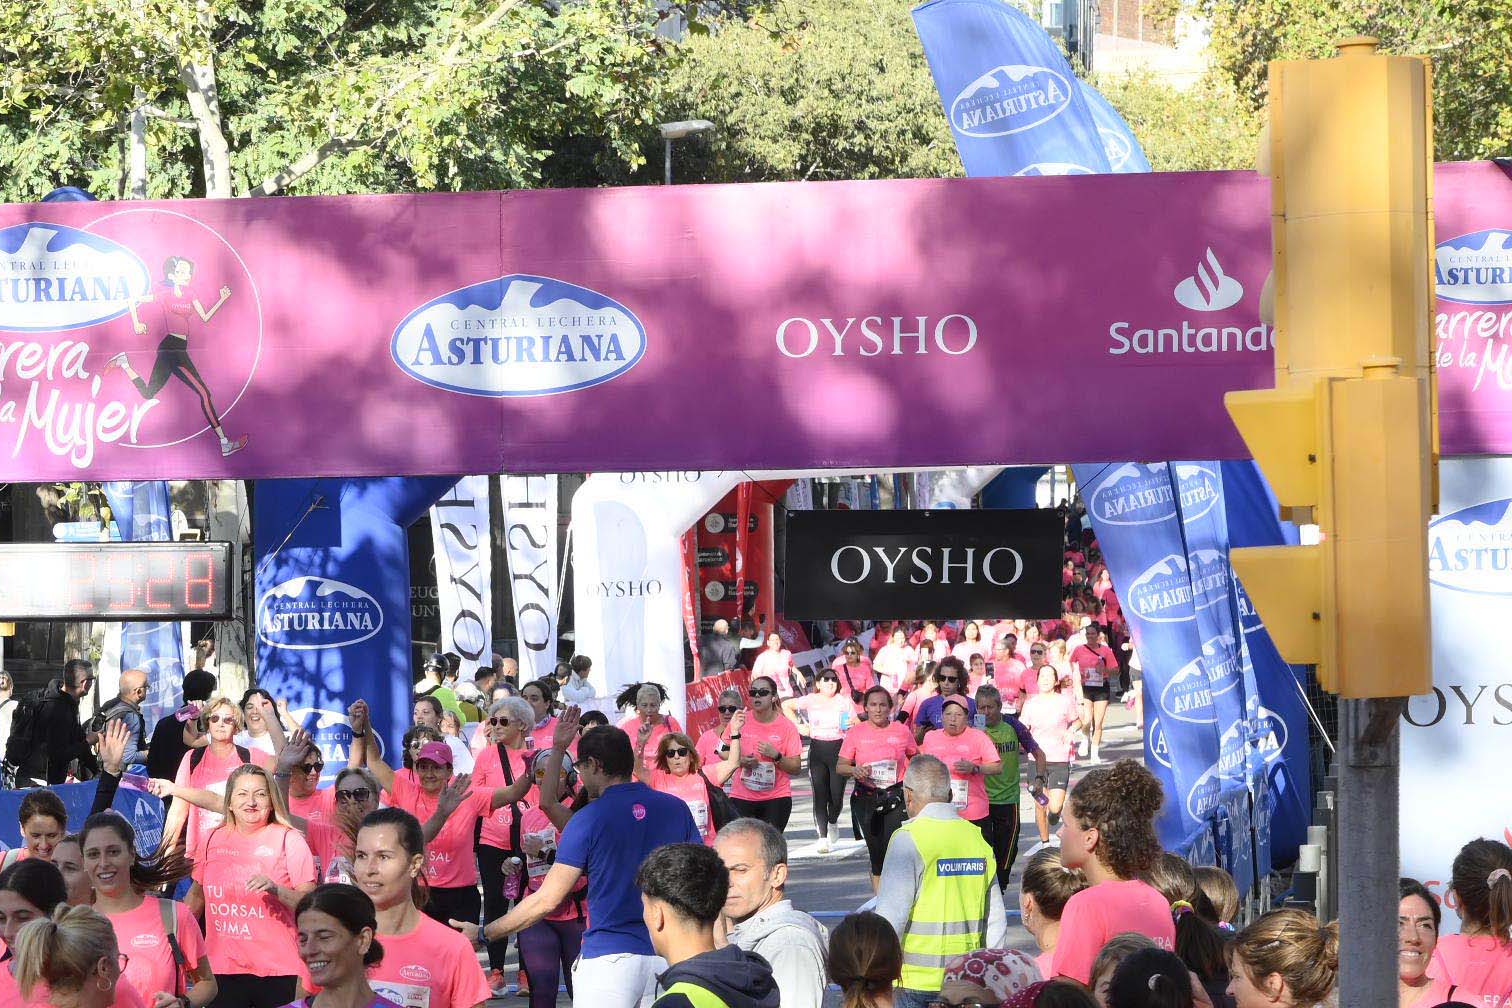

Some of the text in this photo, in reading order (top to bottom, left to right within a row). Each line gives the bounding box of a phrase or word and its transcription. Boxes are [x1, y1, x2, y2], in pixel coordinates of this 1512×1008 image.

[450, 315, 618, 330] CENTRAL LECHERA
[411, 322, 626, 366] ASTURIANA
[776, 313, 978, 359] OYSHO
[11, 375, 161, 469] Mujer
[830, 544, 1024, 586] OYSHO
[273, 601, 316, 610] CENTRAL
[263, 607, 374, 633] ASTURIANA
[207, 885, 223, 898] TU
[210, 903, 265, 919] DORSAL
